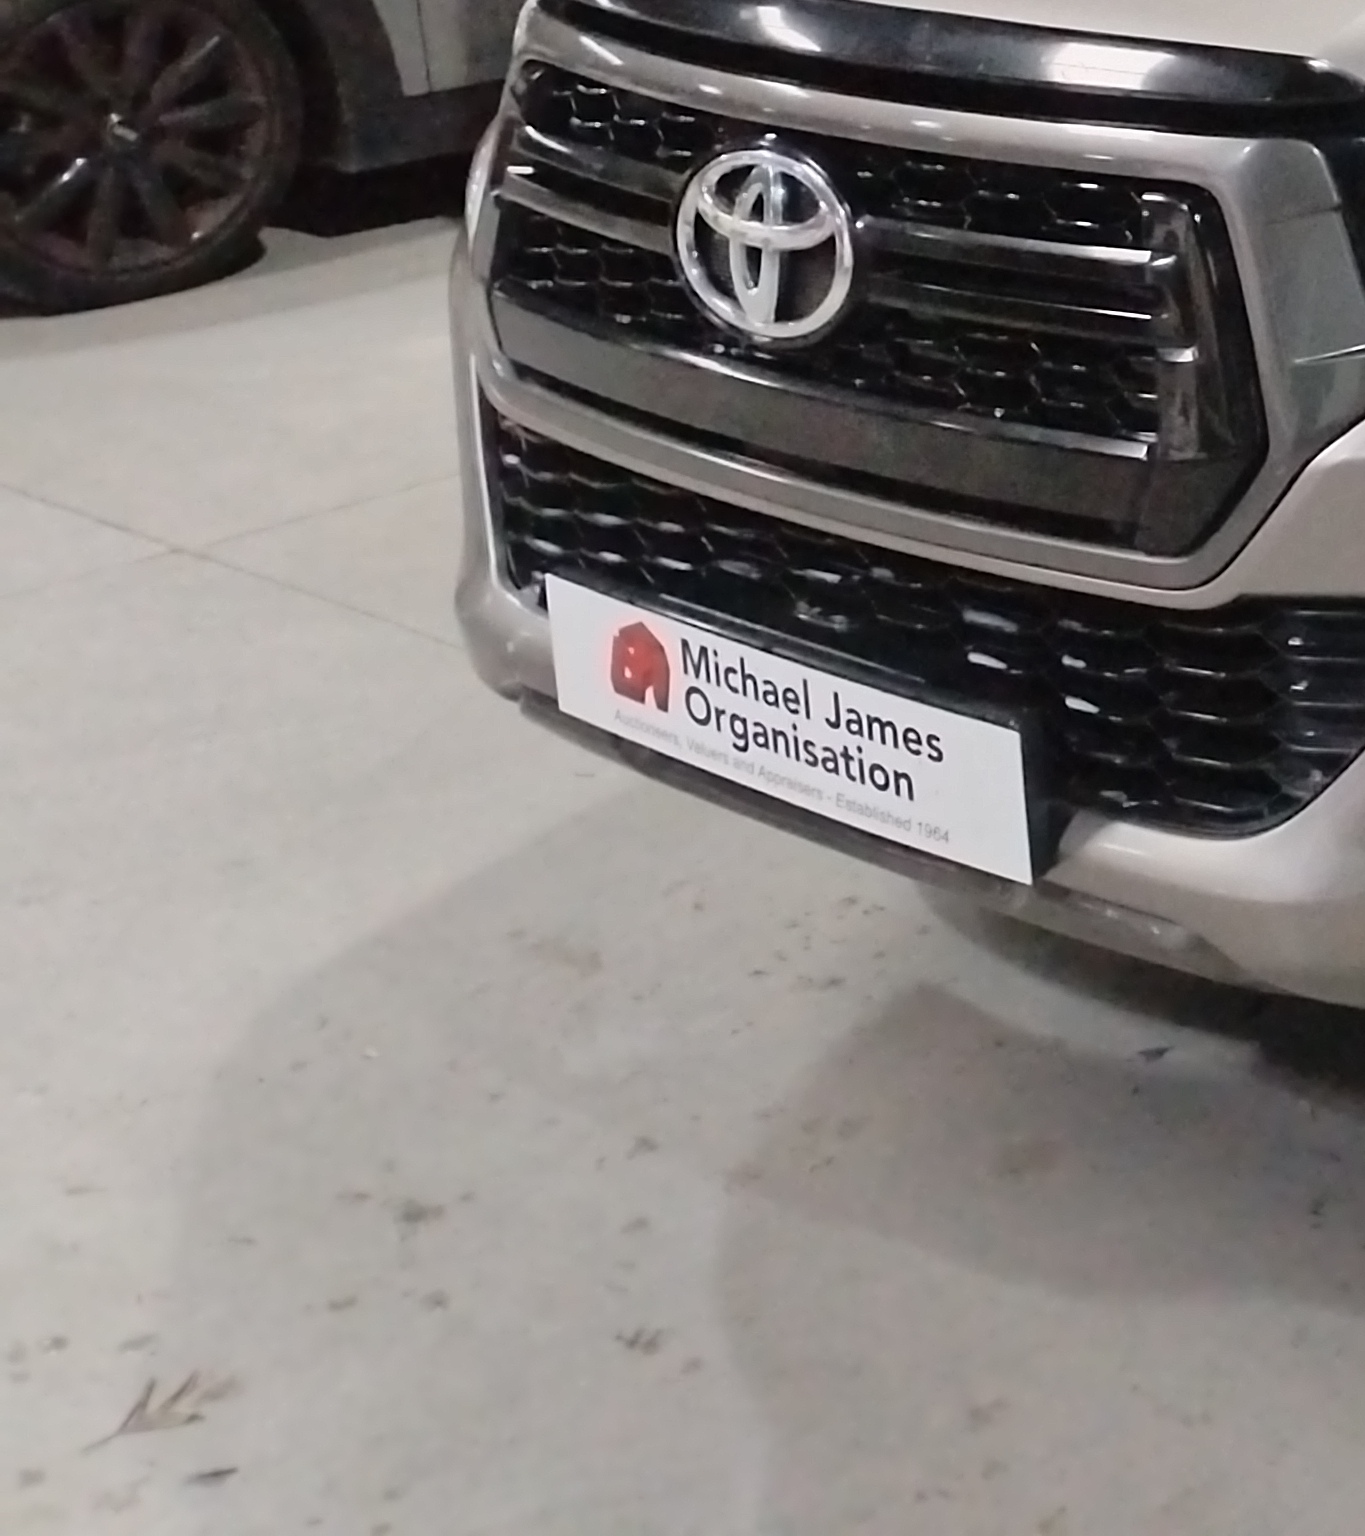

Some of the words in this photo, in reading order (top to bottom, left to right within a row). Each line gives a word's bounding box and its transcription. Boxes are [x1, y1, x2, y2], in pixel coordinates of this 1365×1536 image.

[680, 637, 812, 719] Michael
[825, 691, 945, 763] James
[684, 686, 915, 802] Organisation
[733, 754, 755, 775] and
[757, 763, 824, 802] Appraisers
[835, 793, 912, 834] Established
[916, 820, 950, 844] 1964
